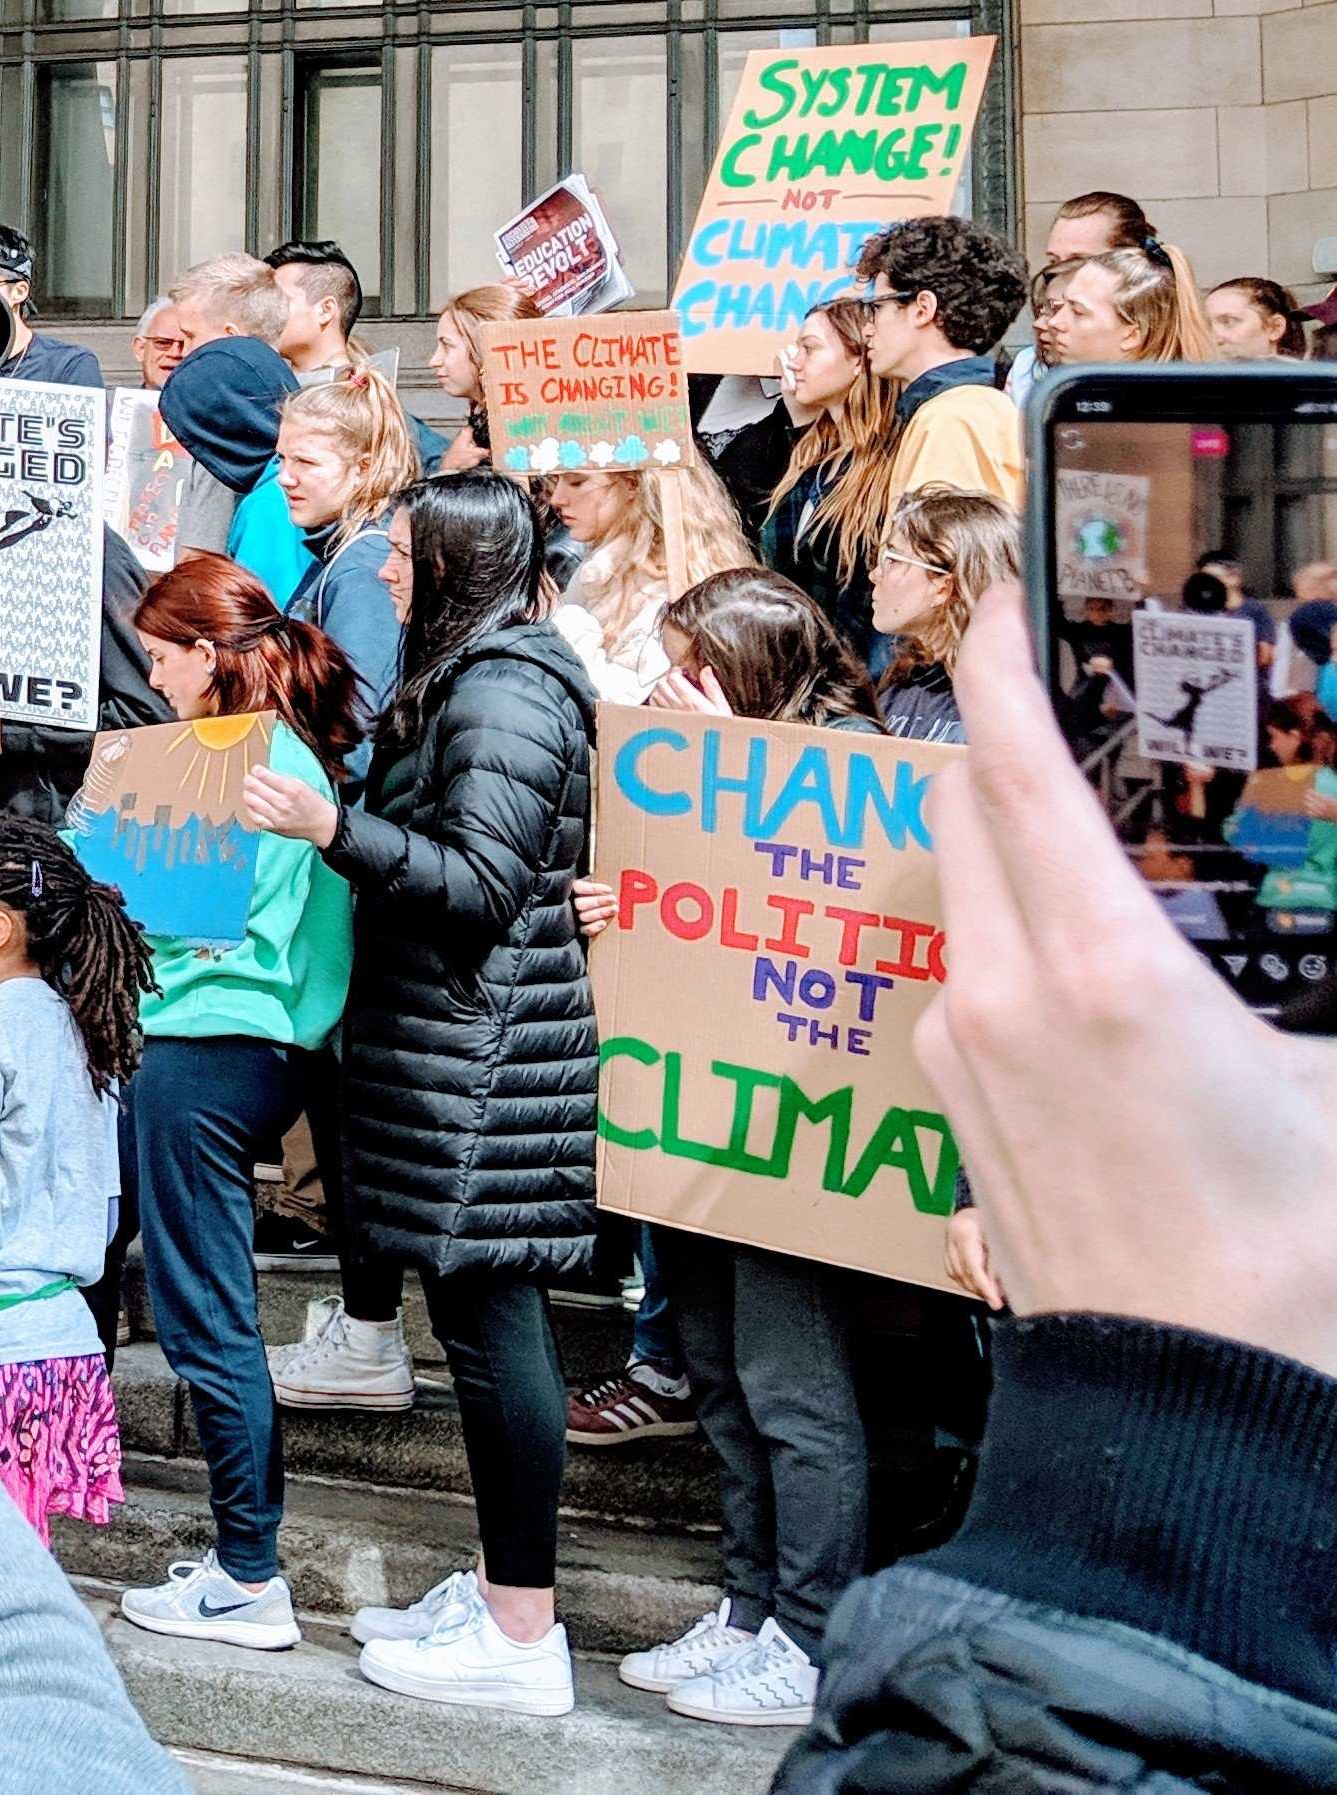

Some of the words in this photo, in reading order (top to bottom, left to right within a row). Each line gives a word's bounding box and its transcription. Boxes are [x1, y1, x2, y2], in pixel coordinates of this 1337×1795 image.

[743, 58, 968, 130] SYSTEM
[719, 123, 962, 188] CHANGE!
[782, 188, 841, 211] NOT
[513, 212, 594, 278] EDUCATION
[523, 233, 591, 293] REVOLT
[691, 216, 887, 270] CLIMAT
[491, 338, 561, 371] THE
[573, 331, 682, 368] CLIMATE
[500, 382, 529, 406] IS
[540, 371, 679, 404] CHANGING!
[754, 841, 867, 890] THE
[752, 956, 894, 1023] NOT
[776, 1012, 873, 1057] THE
